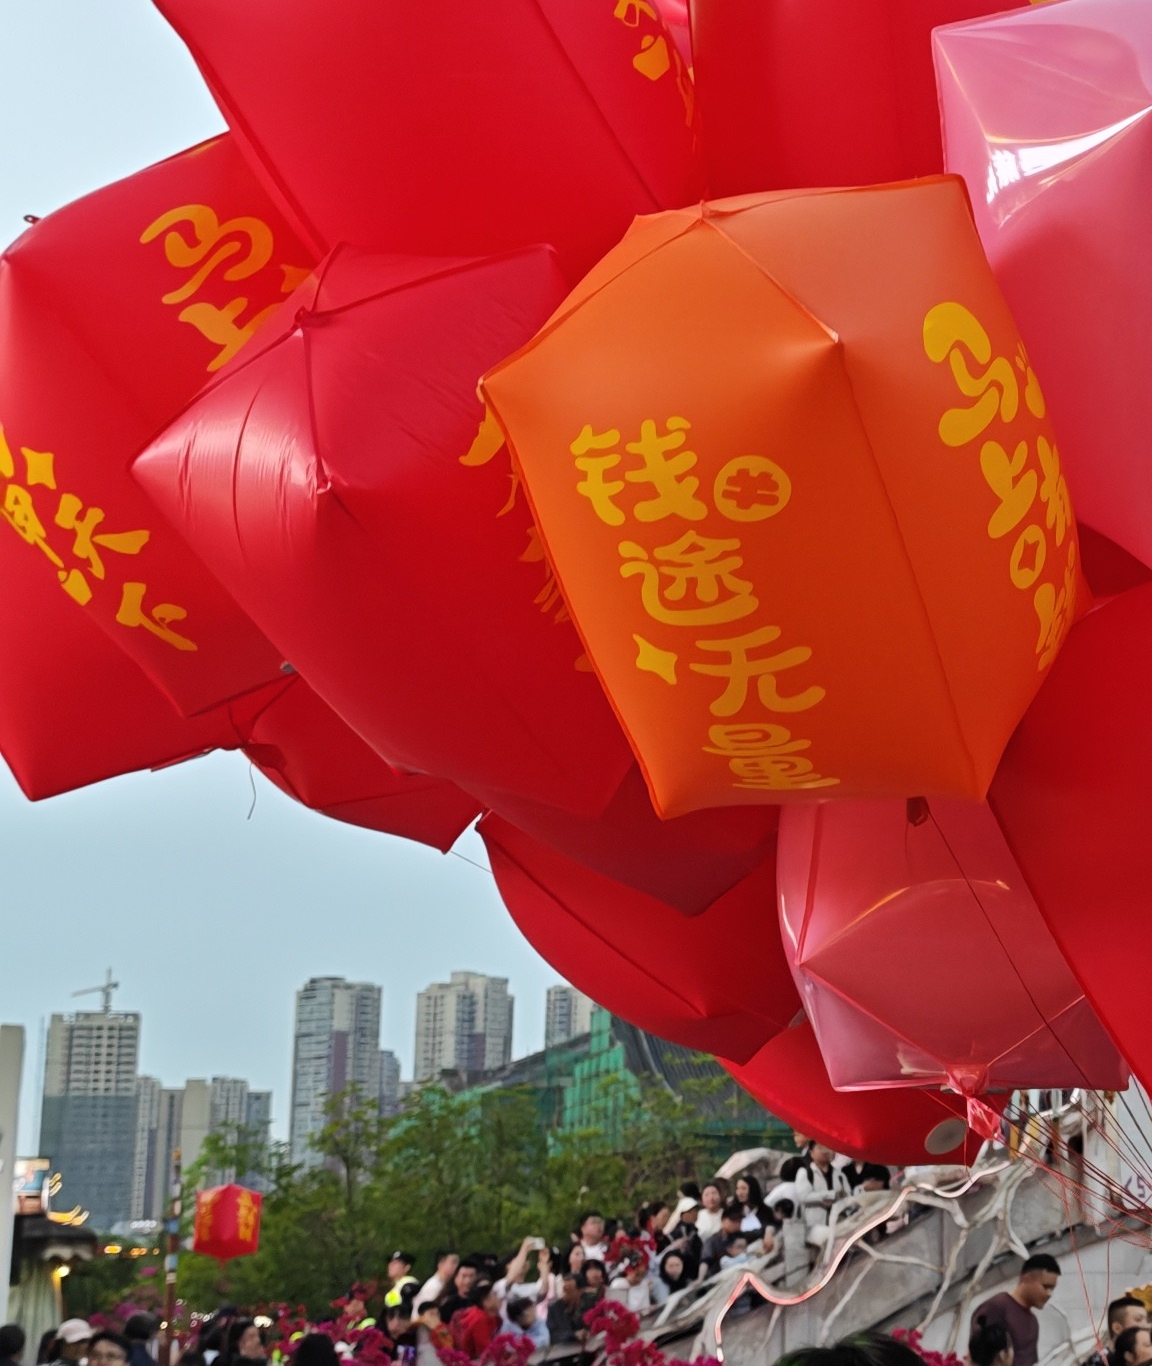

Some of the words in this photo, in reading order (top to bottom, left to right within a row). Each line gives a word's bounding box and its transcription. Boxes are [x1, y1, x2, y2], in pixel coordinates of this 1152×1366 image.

[0, 420, 199, 652] 甲天下
[570, 417, 841, 790] 钱途无量
